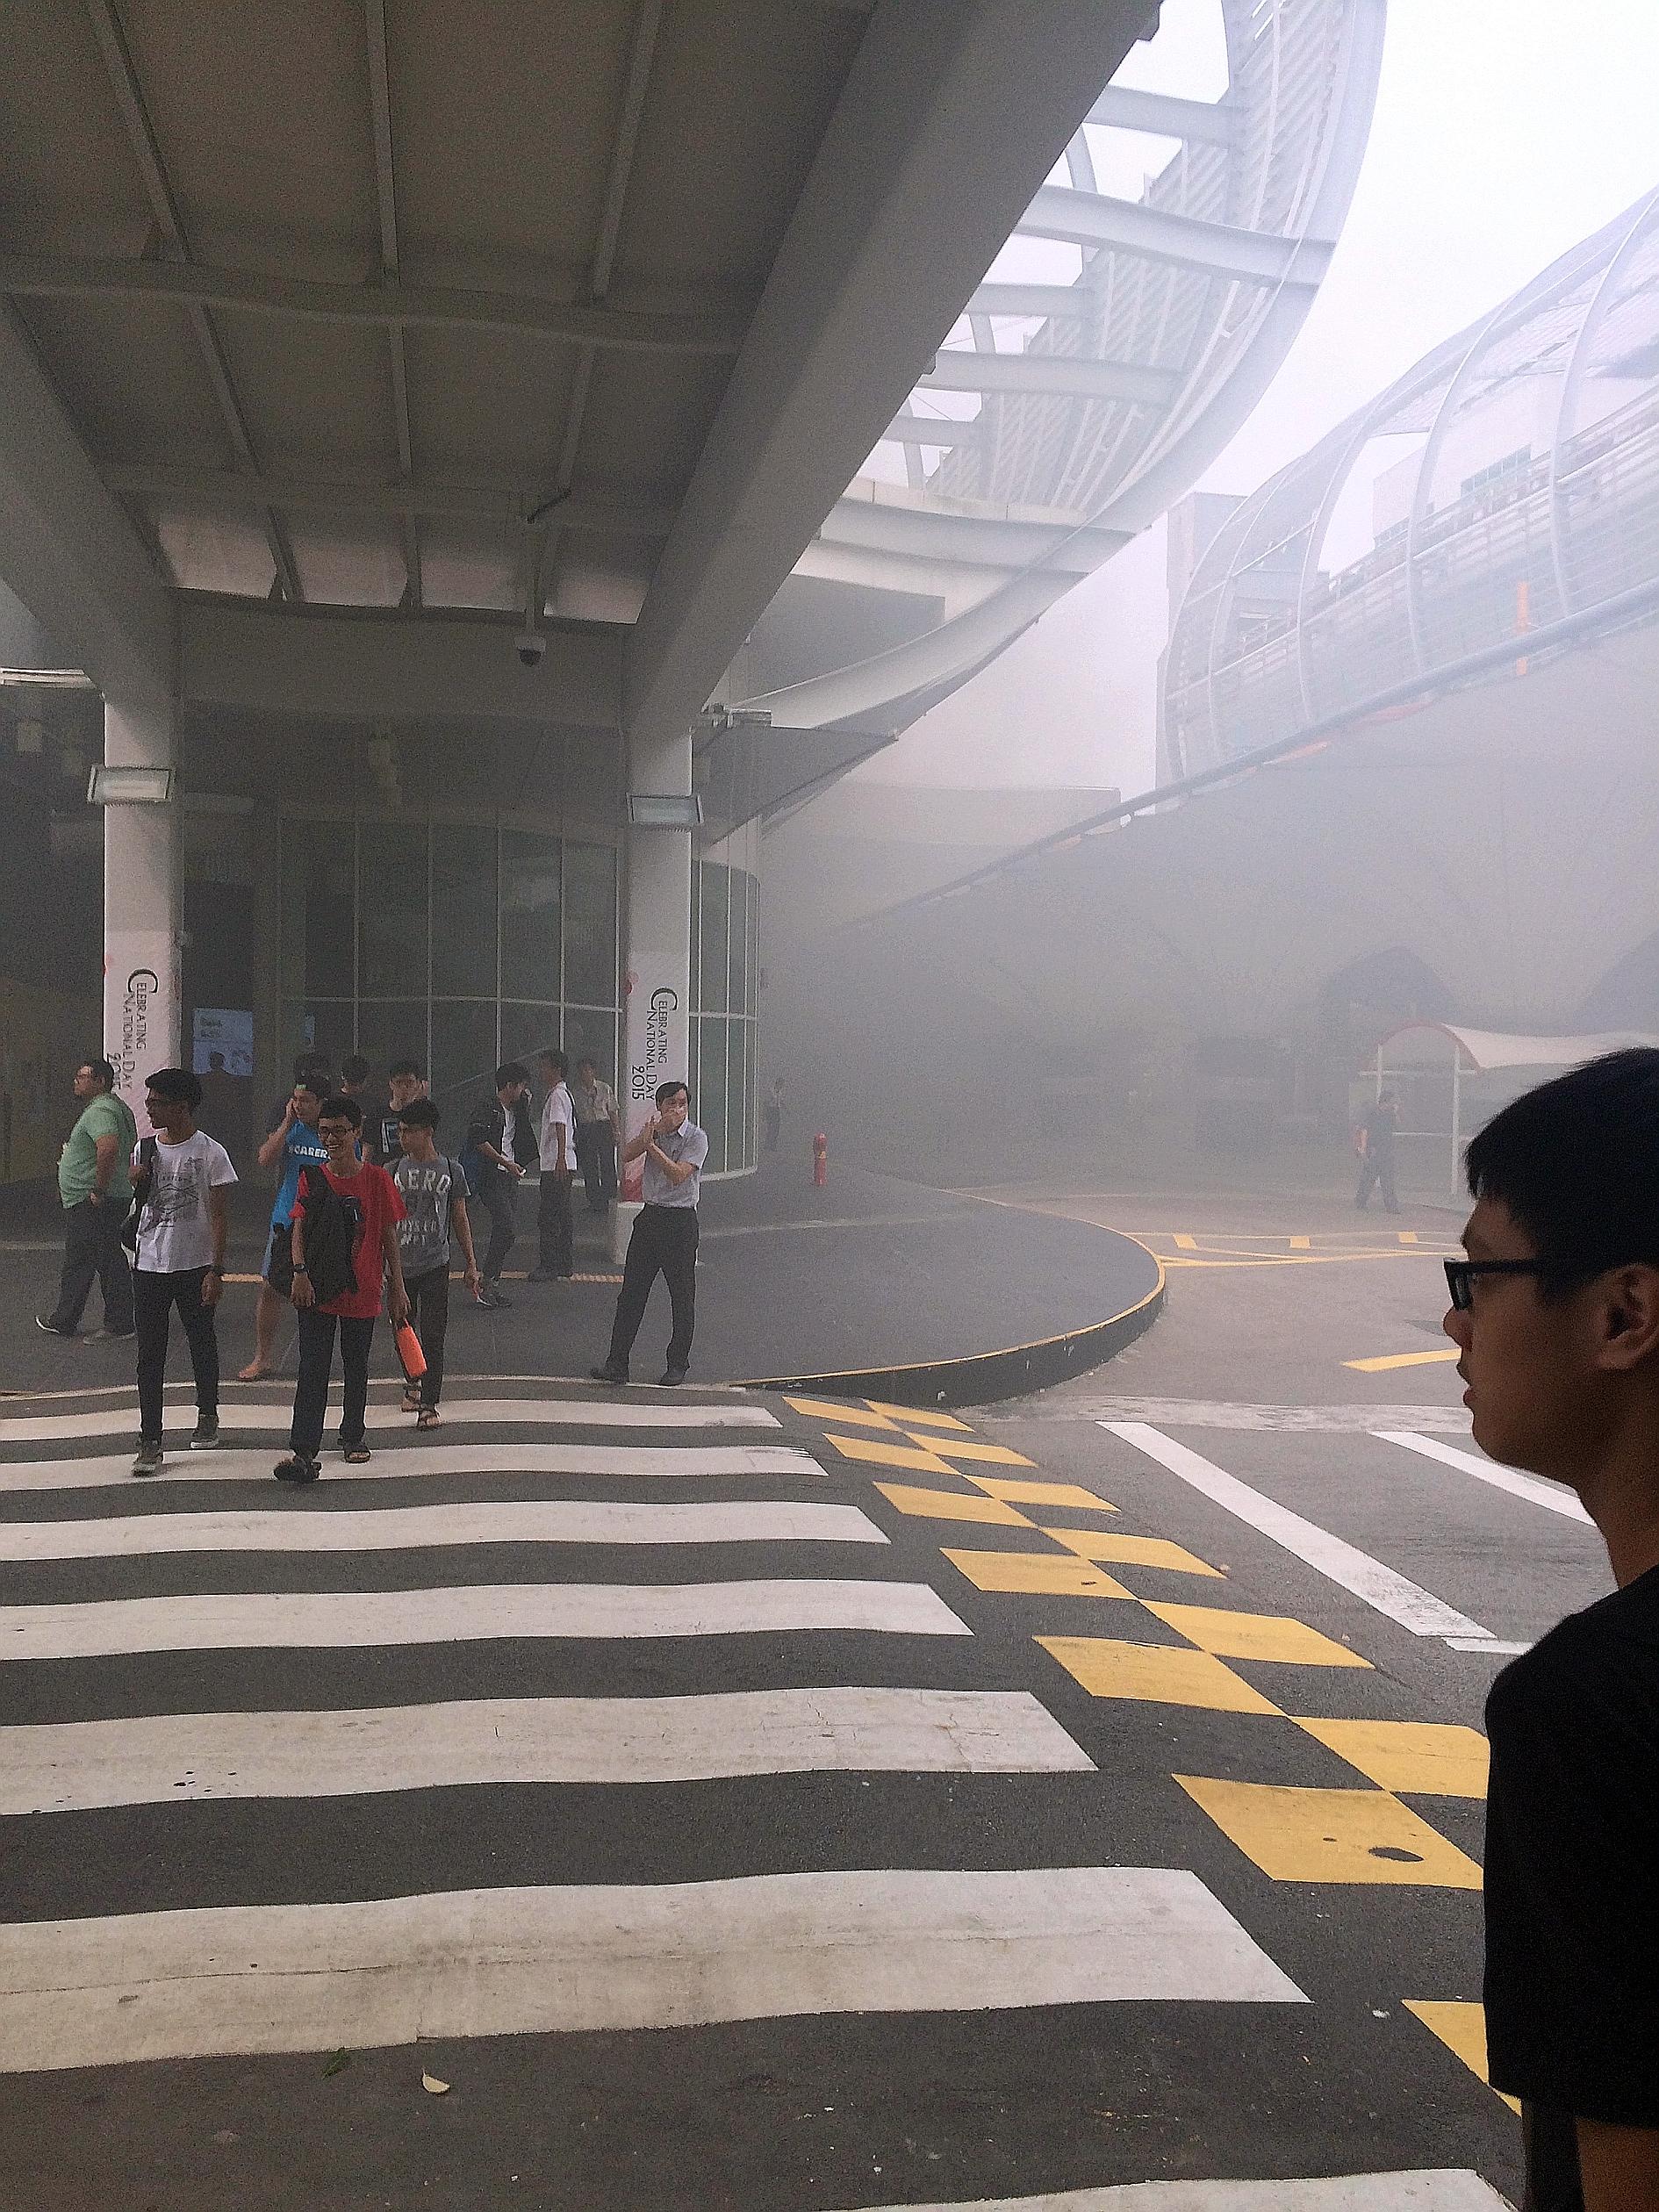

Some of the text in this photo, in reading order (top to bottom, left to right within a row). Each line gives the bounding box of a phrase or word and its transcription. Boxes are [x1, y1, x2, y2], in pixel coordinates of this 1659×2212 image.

[123, 993, 135, 1090] NATIONAL DAY
[128, 968, 158, 1050] CELEBRATING
[650, 988, 678, 1064] CELEBRATING
[632, 1066, 645, 1101] 2015
[646, 1010, 657, 1101] NATIONAL DAY
[394, 1167, 452, 1195] AERO
